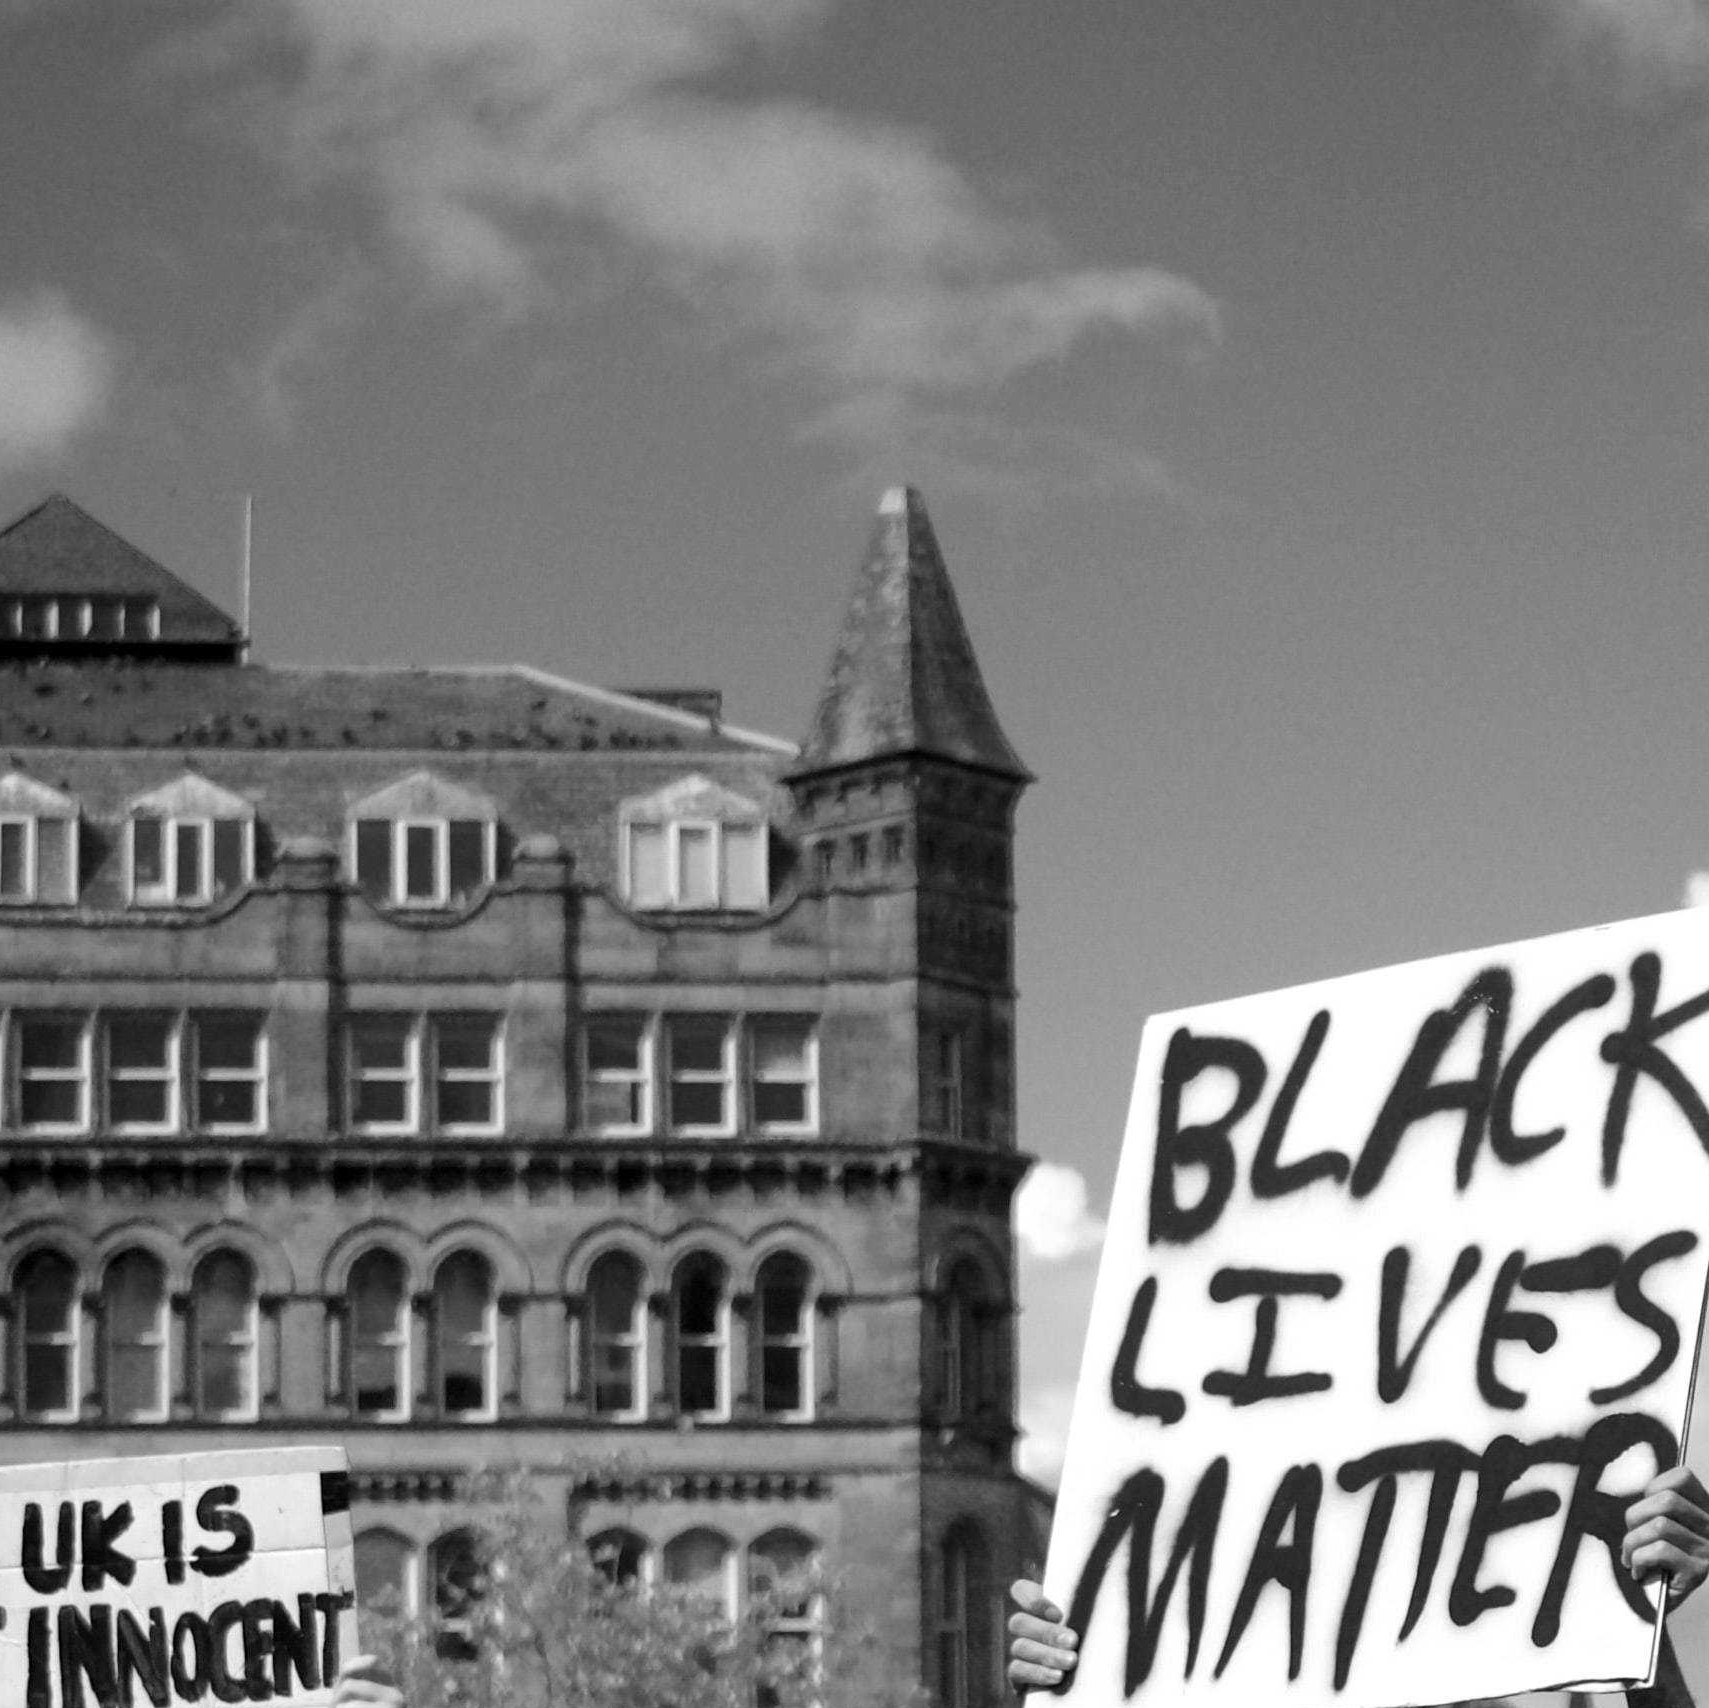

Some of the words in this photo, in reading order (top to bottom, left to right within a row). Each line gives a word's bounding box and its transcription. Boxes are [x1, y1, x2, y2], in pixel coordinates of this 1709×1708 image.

[1110, 1230, 1697, 1425] LIVES
[22, 1500, 136, 1595] UK
[163, 1485, 255, 1585] IS
[1049, 1412, 1679, 1698] MATTER
